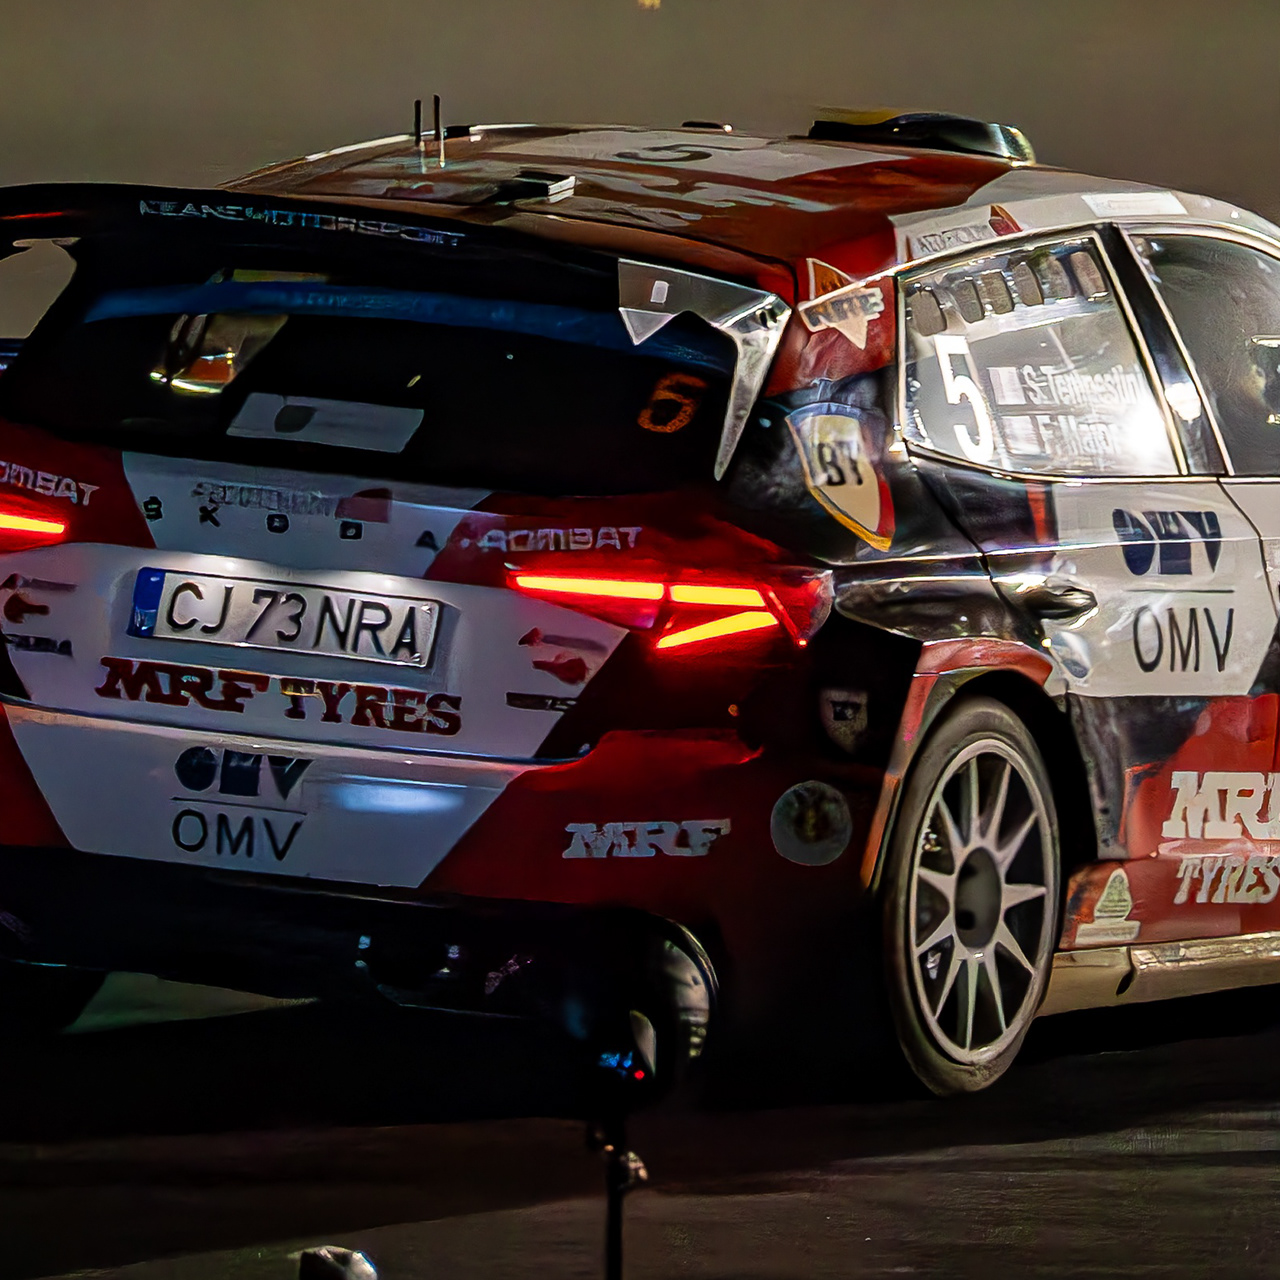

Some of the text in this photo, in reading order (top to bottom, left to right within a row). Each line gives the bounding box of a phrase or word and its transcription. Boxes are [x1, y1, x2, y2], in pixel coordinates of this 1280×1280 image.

[933, 334, 995, 463] 5
[477, 526, 643, 552] ROMBAT
[165, 582, 421, 662] CJ 73 NRA
[1133, 604, 1235, 673] OMV
[95, 656, 463, 737] MRF TYRES
[171, 808, 304, 862] OMV
[561, 818, 732, 858] MRF
